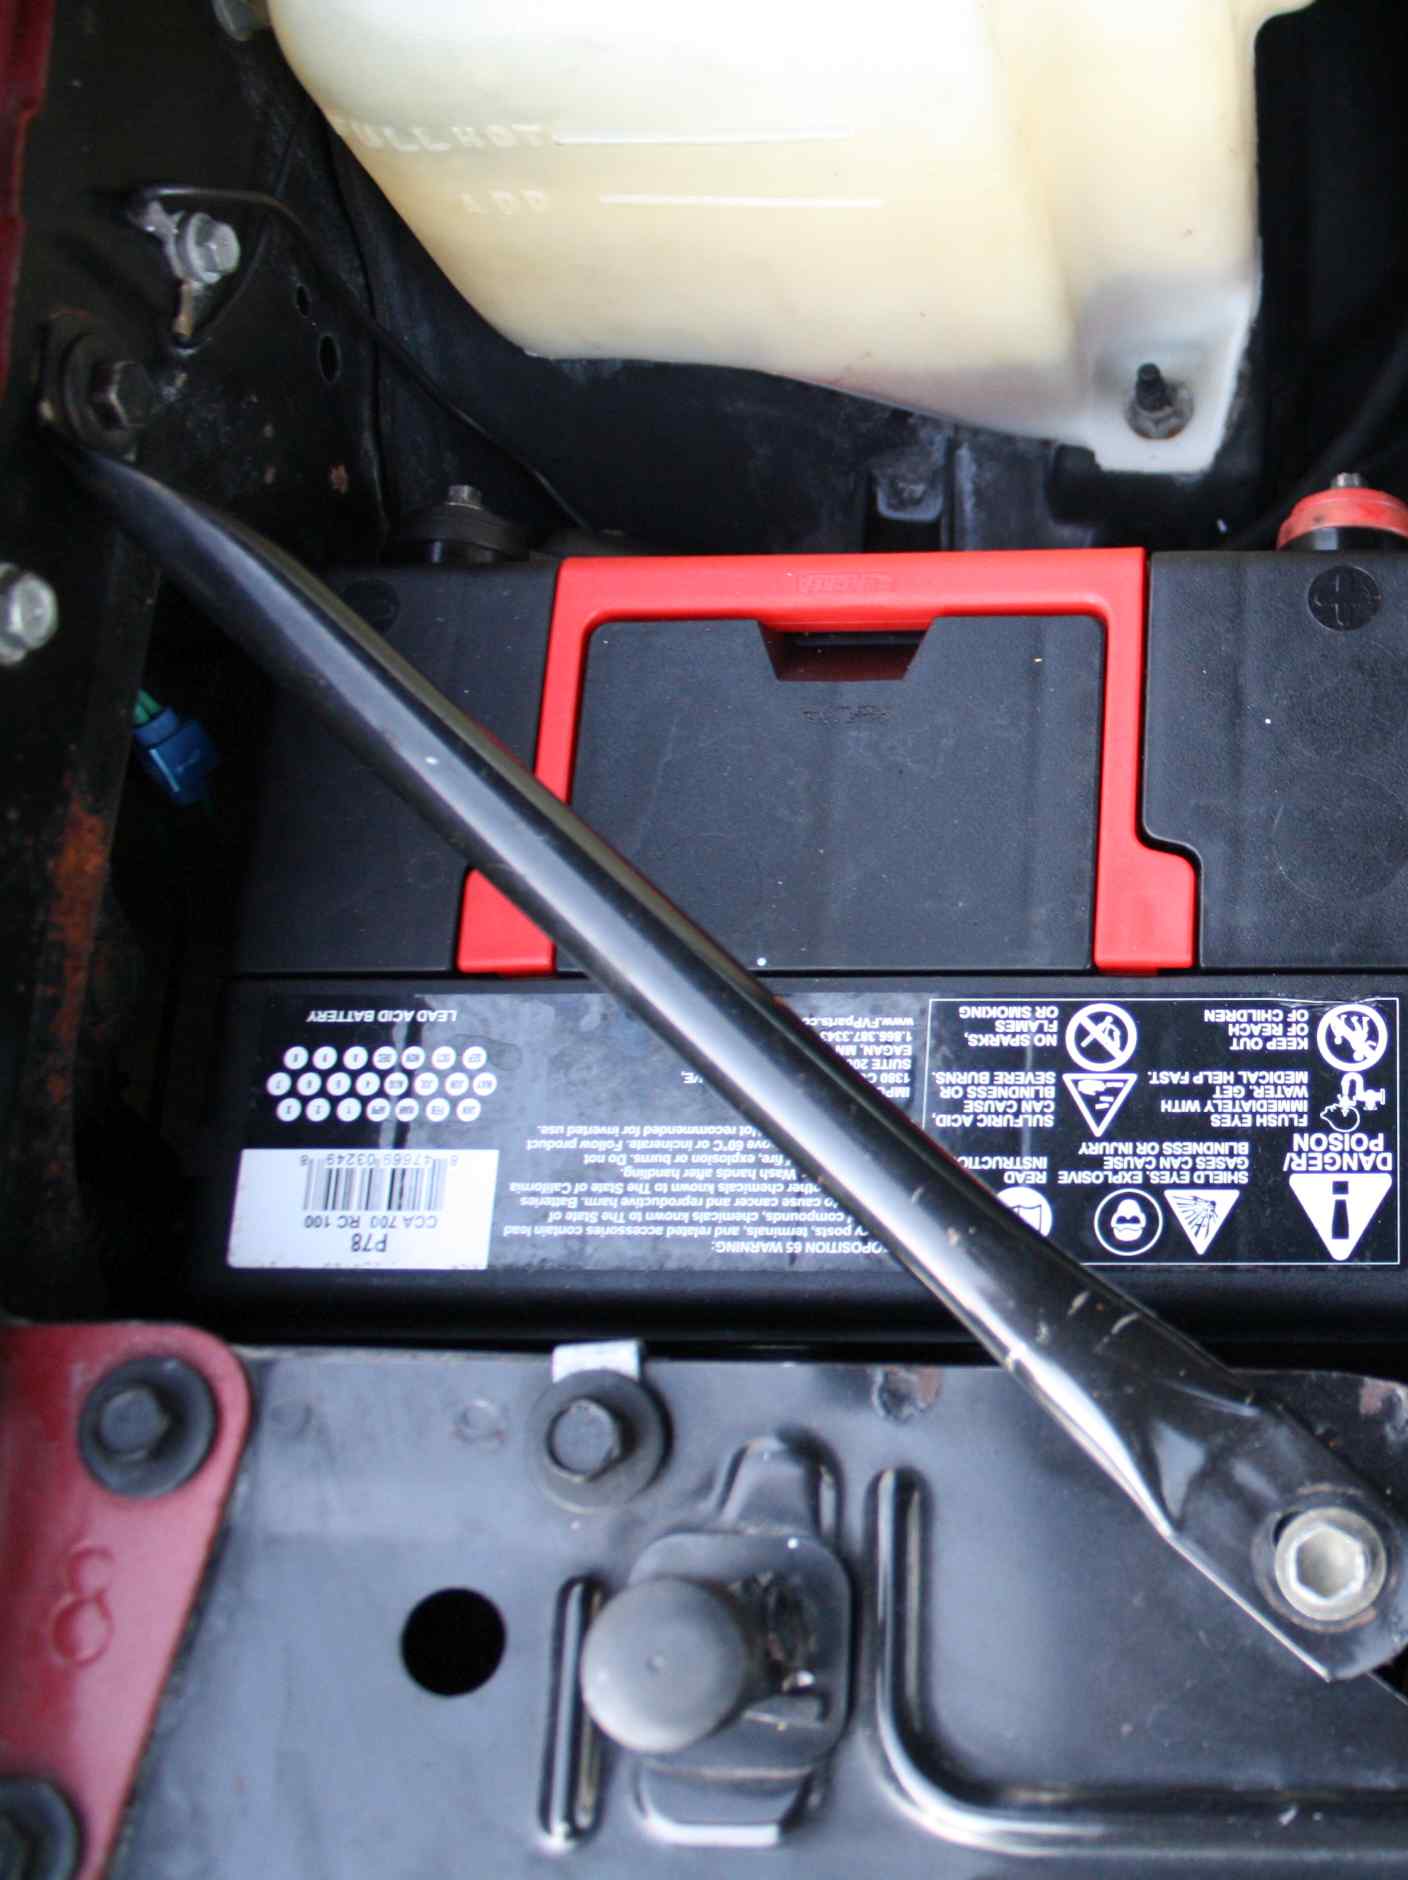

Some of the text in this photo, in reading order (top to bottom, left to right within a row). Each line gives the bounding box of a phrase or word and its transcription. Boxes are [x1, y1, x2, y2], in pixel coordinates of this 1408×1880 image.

[306, 1009, 458, 1022] LEAD ACID BATTERY
[958, 1006, 1059, 1018] OR SMOKING
[1204, 1009, 1309, 1022] OF CHILDREN
[994, 1020, 1059, 1032] FLAMES
[1228, 1024, 1309, 1036] OF REACH
[964, 1033, 1058, 1046] NO SPARKS,
[1229, 1037, 1309, 1050] KEEP OUT
[834, 1044, 913, 1055] EAGAN, MN
[871, 1058, 912, 1069] SUITE
[879, 1072, 910, 1083] 1380
[931, 1072, 1056, 1084] SEVERE BURNS.
[1147, 1071, 1309, 1084] MEDICAL HELP FAST.
[940, 1086, 1056, 1098] BLINDNESS OR
[1213, 1085, 1309, 1098] WATER. GET
[963, 1100, 1055, 1113] CAN CAUSE
[1160, 1099, 1309, 1112] IMMEDIATELY WITH
[931, 1113, 1055, 1126] SULFURIC ACID,
[1210, 1114, 1308, 1126] FLUSH EYES
[536, 1124, 565, 1137] use.
[565, 1124, 620, 1137] inverted
[621, 1124, 641, 1137] for
[642, 1124, 737, 1137] recommended
[525, 1138, 578, 1151] product
[578, 1138, 624, 1151] Follow
[625, 1138, 694, 1151] incinerate.
[695, 1138, 711, 1151] or
[1078, 1142, 1249, 1155] BLINDNESS OR INJURY
[1292, 1133, 1385, 1151] POISON
[583, 1153, 607, 1165] not
[608, 1153, 628, 1165] Do
[630, 1153, 672, 1165] burns.
[673, 1153, 689, 1165] or
[690, 1153, 756, 1165] explosion
[1103, 1156, 1250, 1169] GASES CAN CAUSE
[1282, 1152, 1393, 1172] DANGER/
[619, 1166, 797, 1179] Wash hands after handling.
[1003, 1170, 1047, 1183] READ
[1057, 1170, 1249, 1183] SHIELD EYES. EXPLOSIVE
[509, 1181, 573, 1194] California
[573, 1181, 589, 1194] of
[591, 1181, 625, 1194] State
[626, 1181, 652, 1194] The
[653, 1181, 669, 1194] to
[670, 1181, 715, 1194] known
[717, 1181, 785, 1194] chemicals
[519, 1196, 578, 1208] Batteries
[580, 1196, 619, 1208] harm.
[619, 1196, 704, 1208] reproductive
[705, 1196, 732, 1208] and
[733, 1196, 779, 1208] cancer
[781, 1196, 822, 1208] cause
[305, 1215, 437, 1228] CCA 700 RC 100
[546, 1211, 845, 1223] compounds, chemicals known to The State of
[503, 1225, 532, 1237] lead
[533, 1225, 584, 1237] contain
[585, 1225, 664, 1237] accessories
[665, 1225, 713, 1237] related
[714, 1225, 741, 1237] and
[742, 1225, 809, 1237] terminals,
[810, 1225, 853, 1237] posts,
[350, 1233, 387, 1252] P78
[711, 1241, 888, 1253] OPOSITION 65 WARNING:
